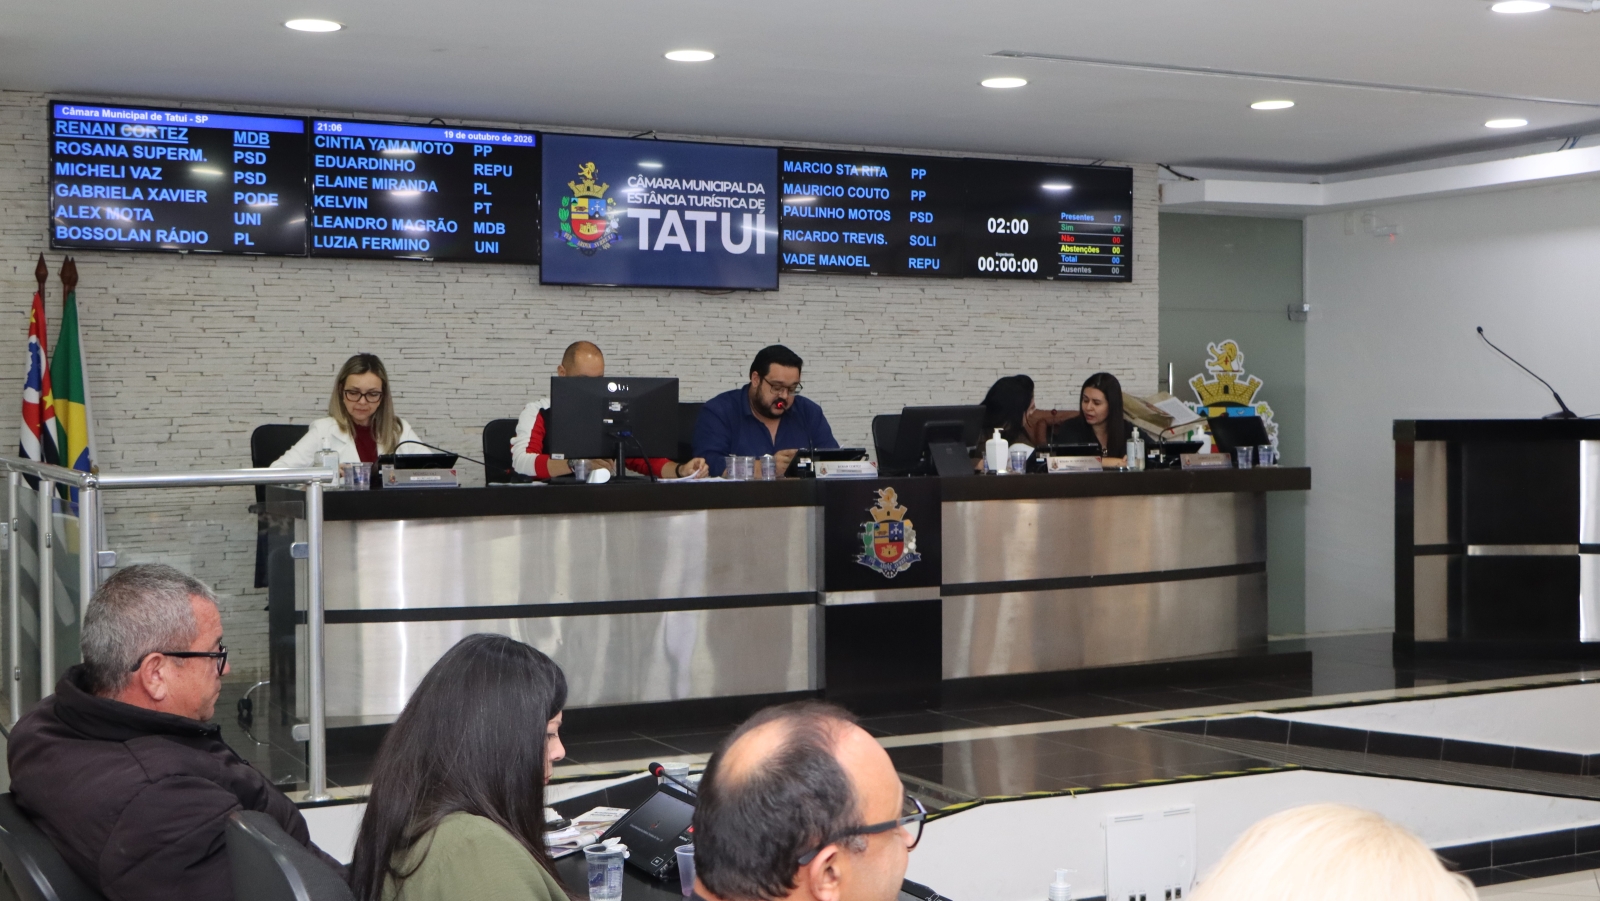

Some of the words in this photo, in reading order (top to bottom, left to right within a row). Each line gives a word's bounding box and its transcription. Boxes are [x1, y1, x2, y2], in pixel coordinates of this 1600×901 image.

[62, 106, 100, 117] Câmara
[102, 109, 148, 121] Municipal
[150, 112, 162, 121] de
[195, 115, 208, 124] SP
[56, 121, 115, 136] RENAN
[120, 124, 188, 140] CORTEZ
[317, 123, 342, 132] 21:06
[233, 131, 270, 145] MDB
[468, 132, 500, 141] outubro
[514, 135, 532, 143] 2026
[56, 142, 128, 157] ROSANA
[133, 146, 207, 162] SUPERM.
[315, 136, 365, 150] CINTIA
[368, 139, 454, 155] YAMAMOTO
[473, 146, 492, 157] PP
[234, 152, 266, 164] PSD
[315, 155, 415, 172] EDUARDINHO
[56, 163, 125, 178] MICHELI
[130, 166, 162, 180] VAZ
[473, 164, 513, 177] REPU
[783, 161, 832, 174] MARCIO
[836, 165, 858, 176] STA
[861, 166, 888, 178] RITA
[911, 169, 926, 179] PP
[234, 172, 266, 184] PSD
[315, 175, 368, 189] ELAINE
[372, 178, 438, 192] MIRANDA
[627, 174, 681, 189] CÂMARA
[682, 179, 746, 193] MUNICIPAL
[748, 183, 765, 194] DA
[56, 184, 143, 200] GABRIELA
[148, 188, 207, 203] XAVIER
[474, 184, 492, 195] PL
[783, 183, 844, 196] MAURICIO
[848, 187, 890, 199] COUTO
[911, 191, 926, 201] PP
[234, 192, 278, 206] PODE
[314, 195, 368, 209] KELVIN
[627, 191, 686, 206] ESTÂNCIA
[688, 194, 747, 209] TURÍSTICA
[748, 198, 765, 209] DE
[56, 205, 101, 219] ALEX
[106, 207, 154, 222] MOTA
[474, 203, 492, 214] PT
[783, 206, 844, 219] PAULINHO
[848, 209, 891, 221] MOTOS
[234, 213, 261, 225] UNI
[314, 215, 388, 230] LEANDRO
[392, 218, 458, 233] MAGRÃO
[910, 212, 933, 223] PSD
[1061, 213, 1094, 221] Presentes
[473, 222, 506, 234] MDB
[627, 208, 766, 254] TATUÍ
[987, 218, 1029, 234] 02:00
[56, 227, 150, 242] BOSSOLAN
[156, 227, 209, 244] RÁDIO
[234, 233, 254, 245] PL
[783, 230, 839, 243] RICARDO
[843, 232, 888, 245] TREVIS.
[909, 235, 936, 246] SOLI
[314, 236, 358, 249] LUZIA
[362, 237, 430, 251] FERMINO
[474, 241, 498, 254] UNI
[1061, 245, 1099, 254] Abstenções
[783, 253, 815, 265] VADE
[819, 255, 870, 267] MANOEL
[908, 258, 940, 269] REPU
[978, 256, 1038, 273] 00:00:00
